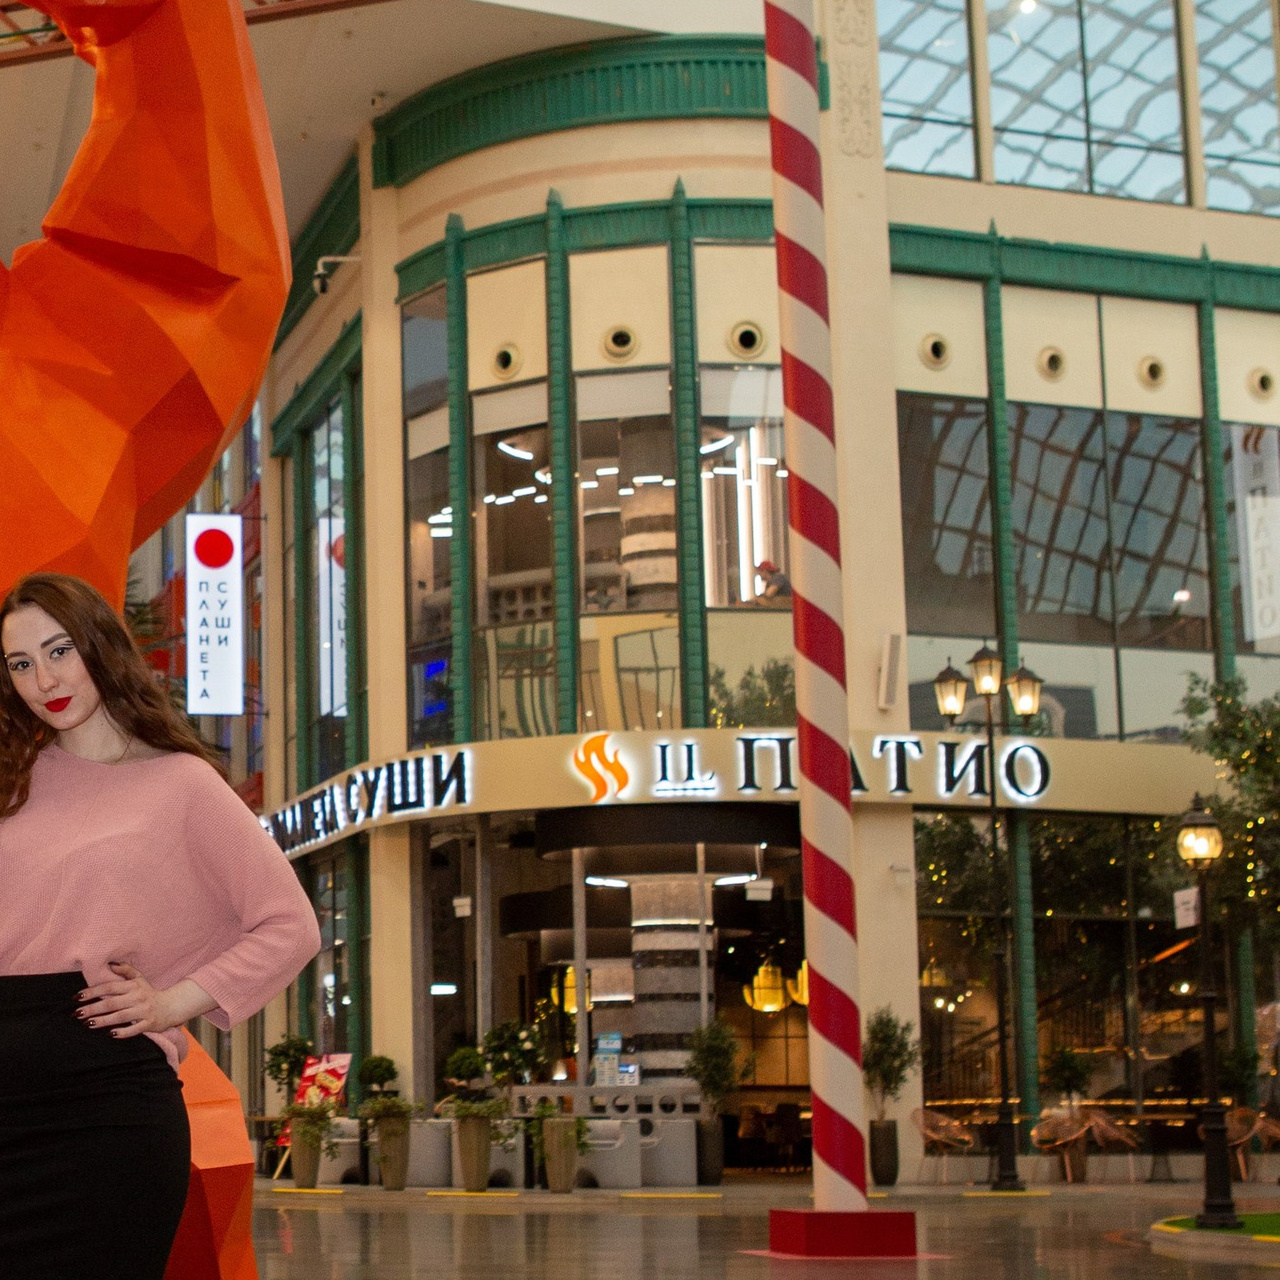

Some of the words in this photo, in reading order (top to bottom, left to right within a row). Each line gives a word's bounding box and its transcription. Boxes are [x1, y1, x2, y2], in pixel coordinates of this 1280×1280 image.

[198, 581, 211, 700] ПЛАНЕТА
[215, 581, 232, 647] СУШИ
[346, 750, 470, 824] СУШИ
